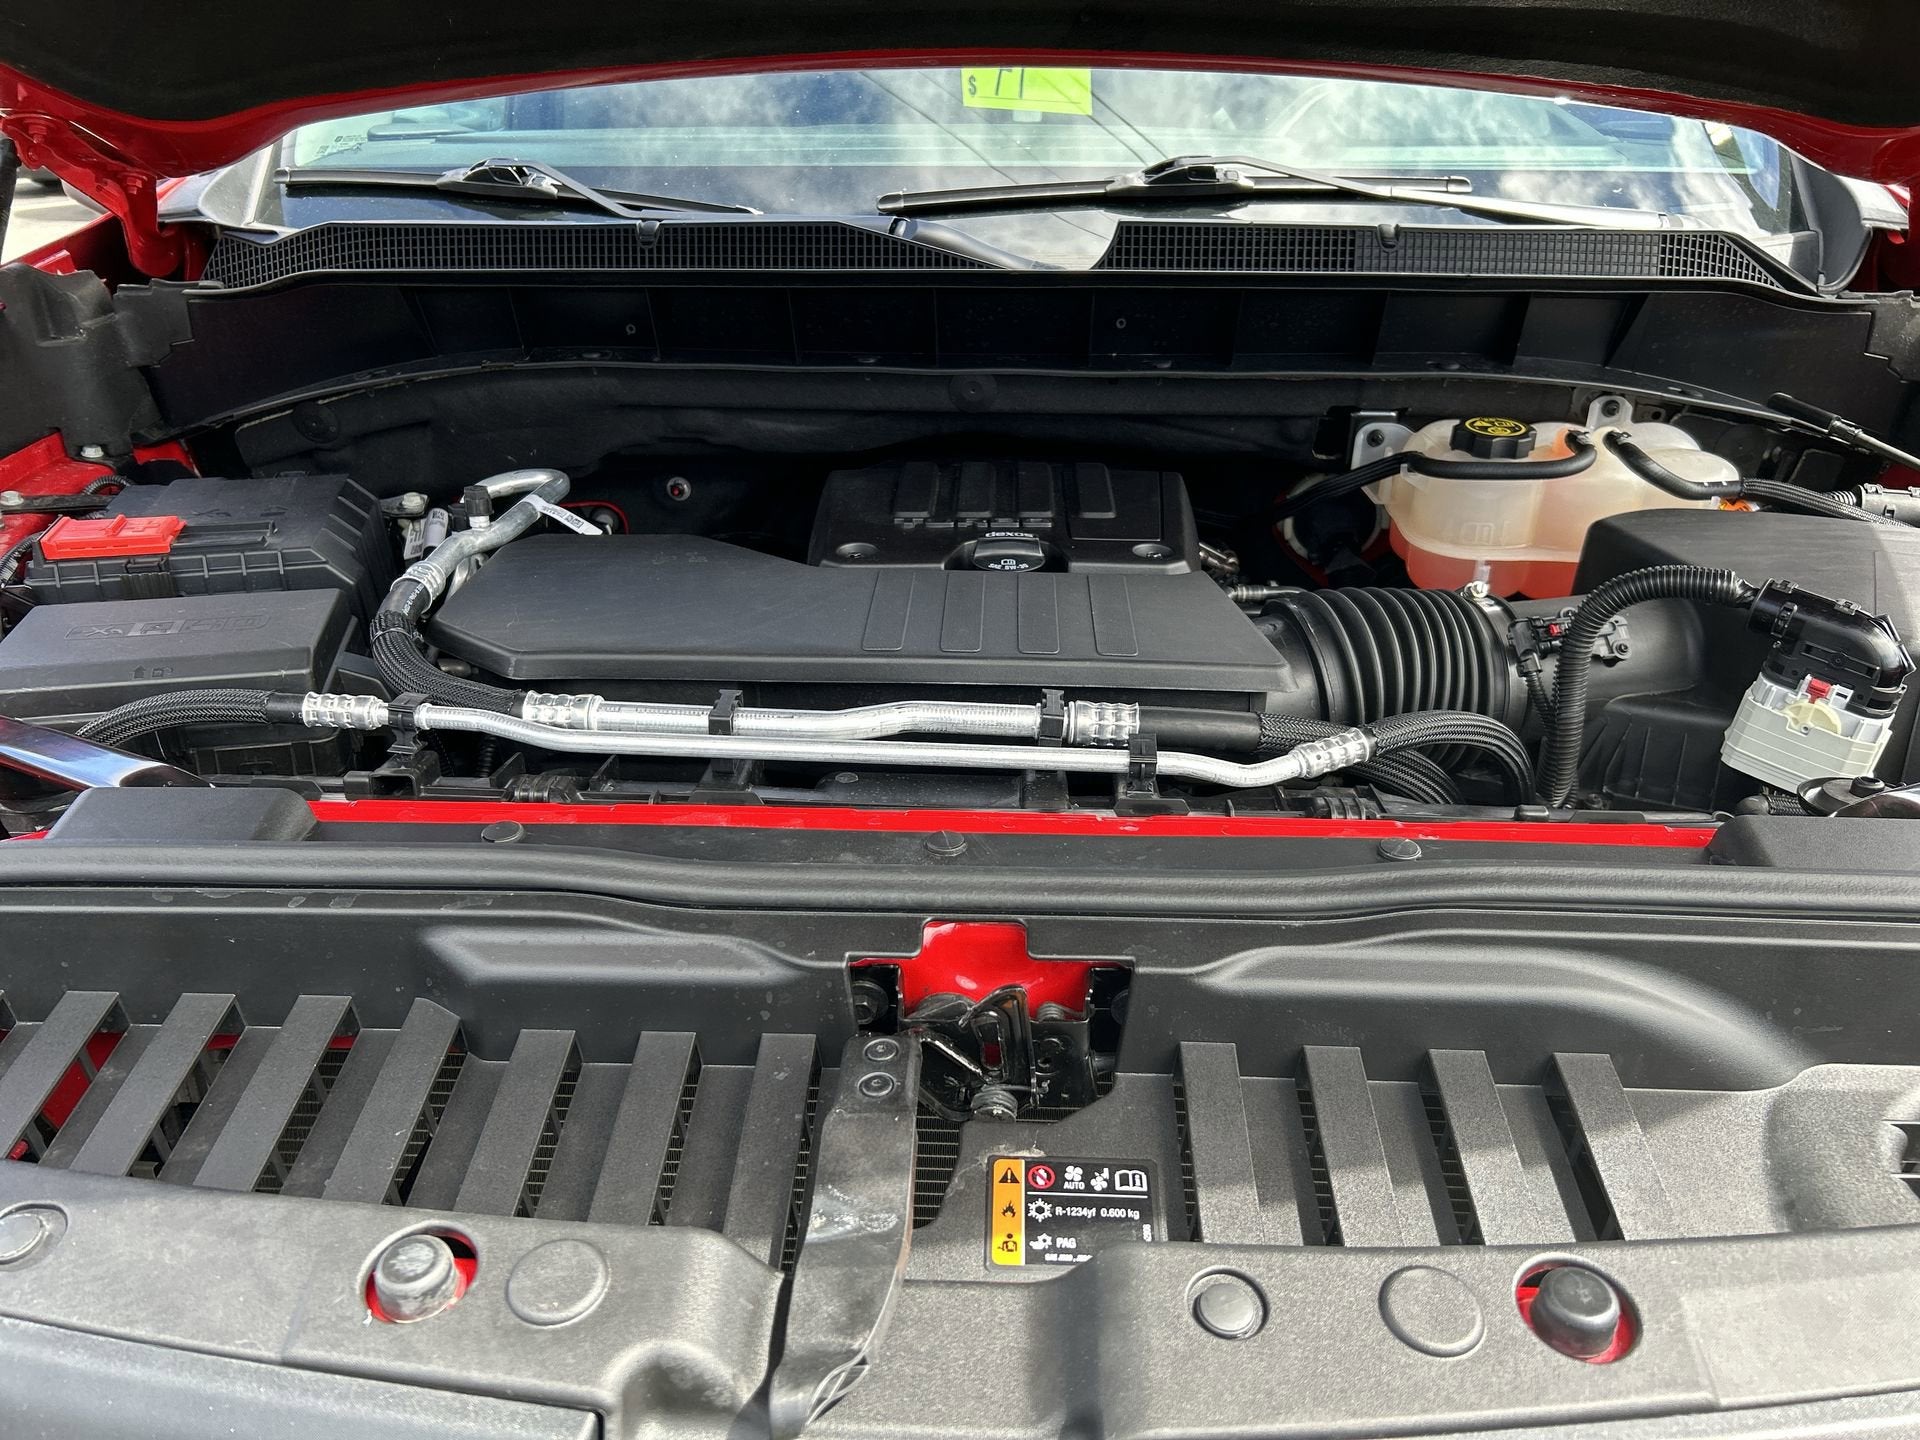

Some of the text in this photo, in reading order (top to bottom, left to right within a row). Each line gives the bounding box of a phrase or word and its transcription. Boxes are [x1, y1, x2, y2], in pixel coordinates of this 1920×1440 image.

[1063, 1181, 1085, 1190] AUTO
[1055, 1207, 1140, 1219] R-1234yf 0.600 kg
[1056, 1237, 1077, 1249] PAG
